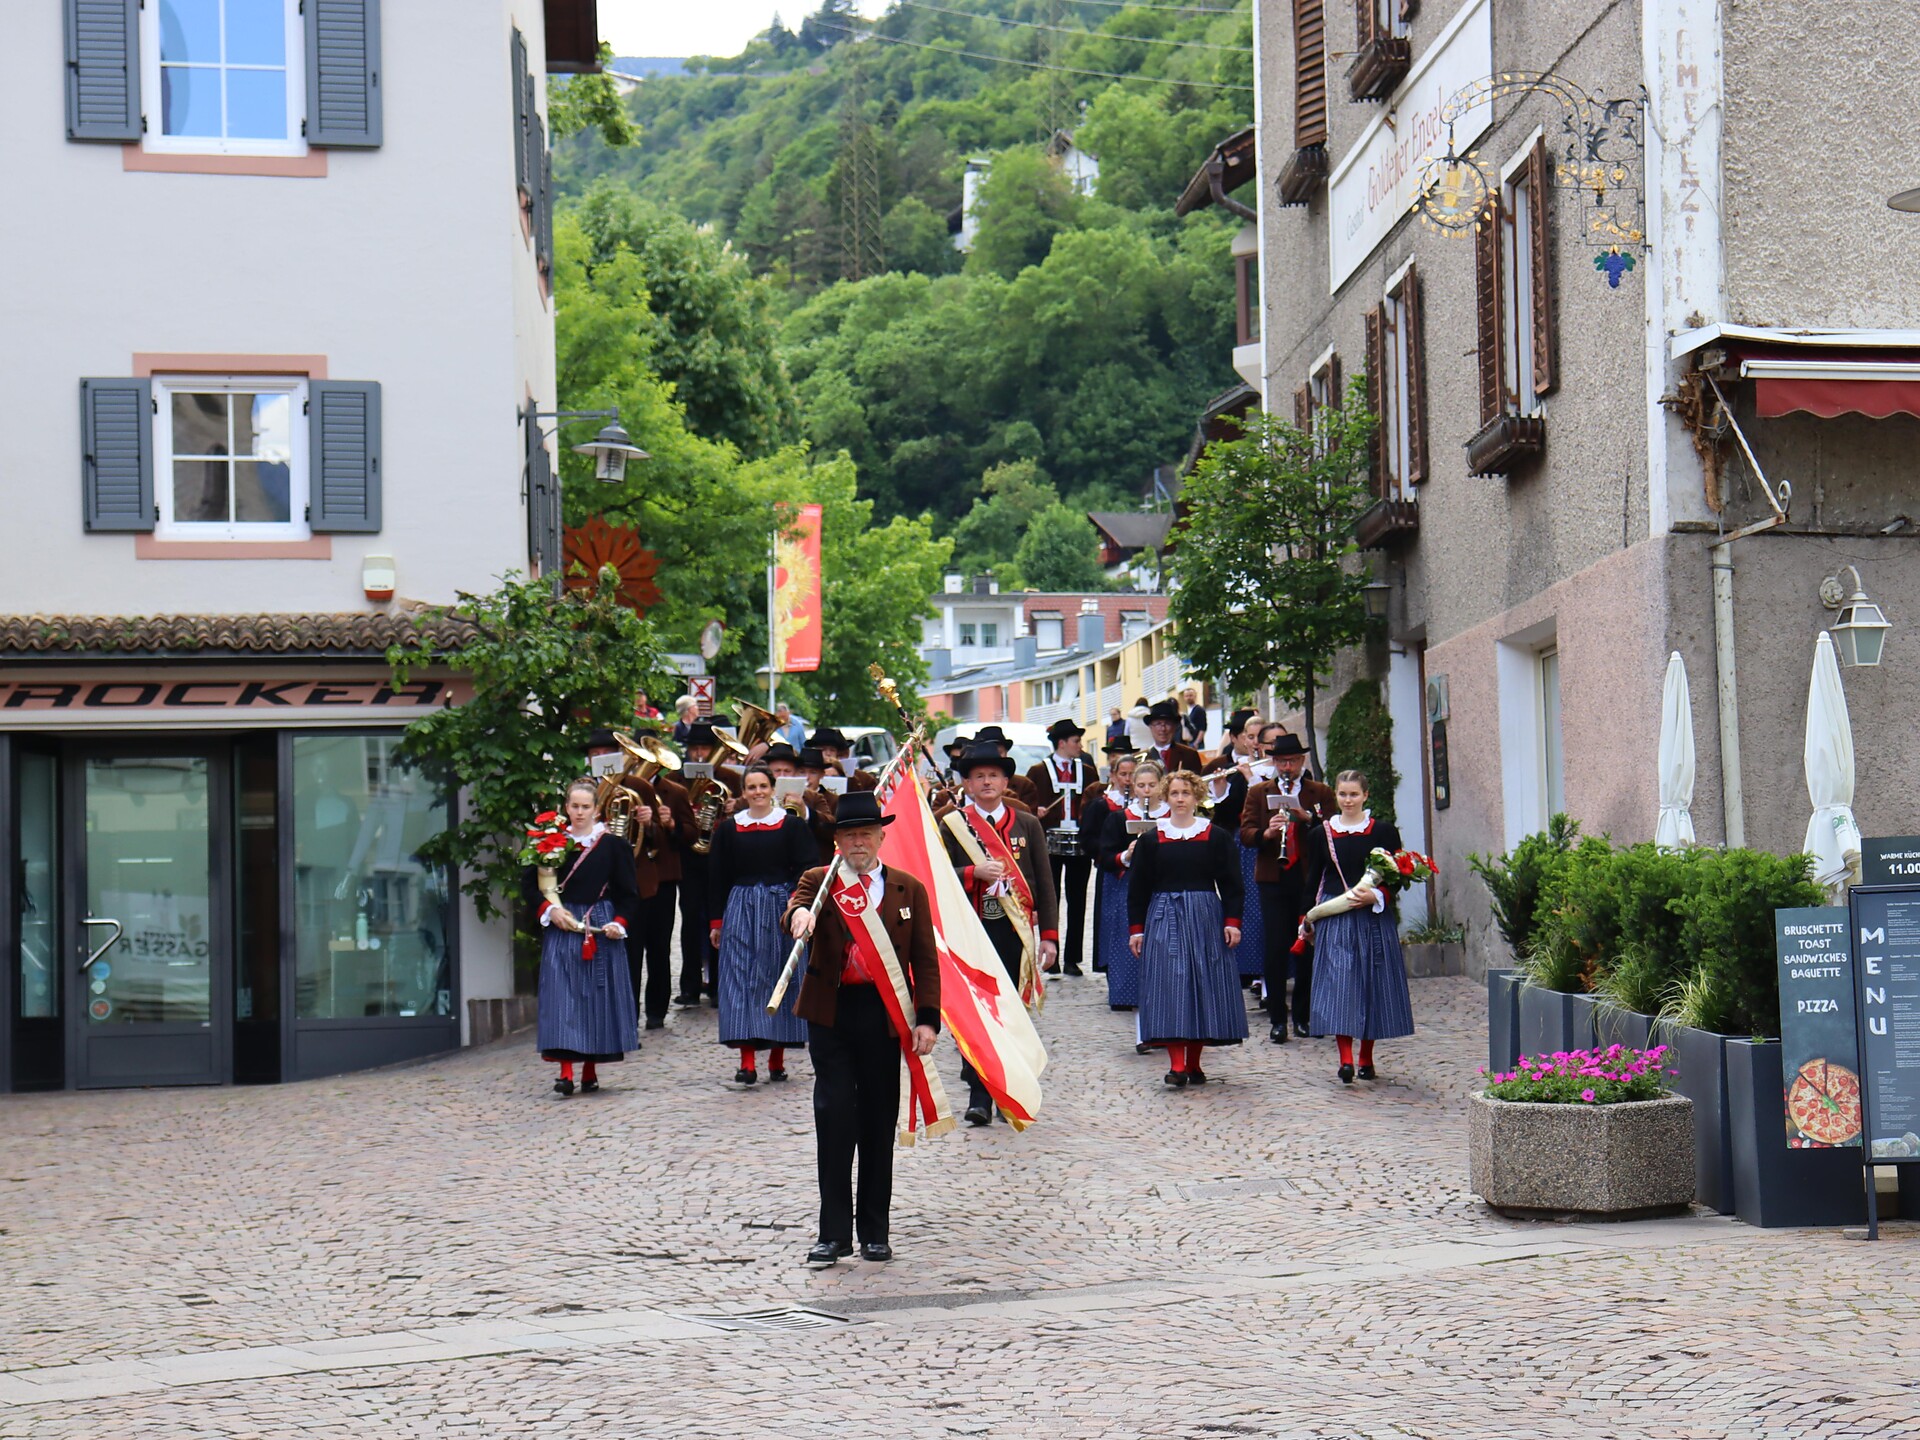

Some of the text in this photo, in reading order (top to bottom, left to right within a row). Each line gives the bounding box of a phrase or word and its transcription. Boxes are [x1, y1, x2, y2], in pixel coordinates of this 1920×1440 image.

[1368, 139, 1409, 213] Goldener
[1411, 85, 1442, 165] Engel
[0, 682, 444, 707] ROCKER
[1880, 852, 1903, 860] WARME
[1784, 924, 1844, 936] BRUSCHETTE
[1797, 938, 1832, 949] TOAST
[1784, 953, 1848, 965] SANDWICHES
[1791, 967, 1842, 979] BAGUETTE
[1860, 927, 1887, 1035] MENU
[1797, 999, 1839, 1014] PIZZA
